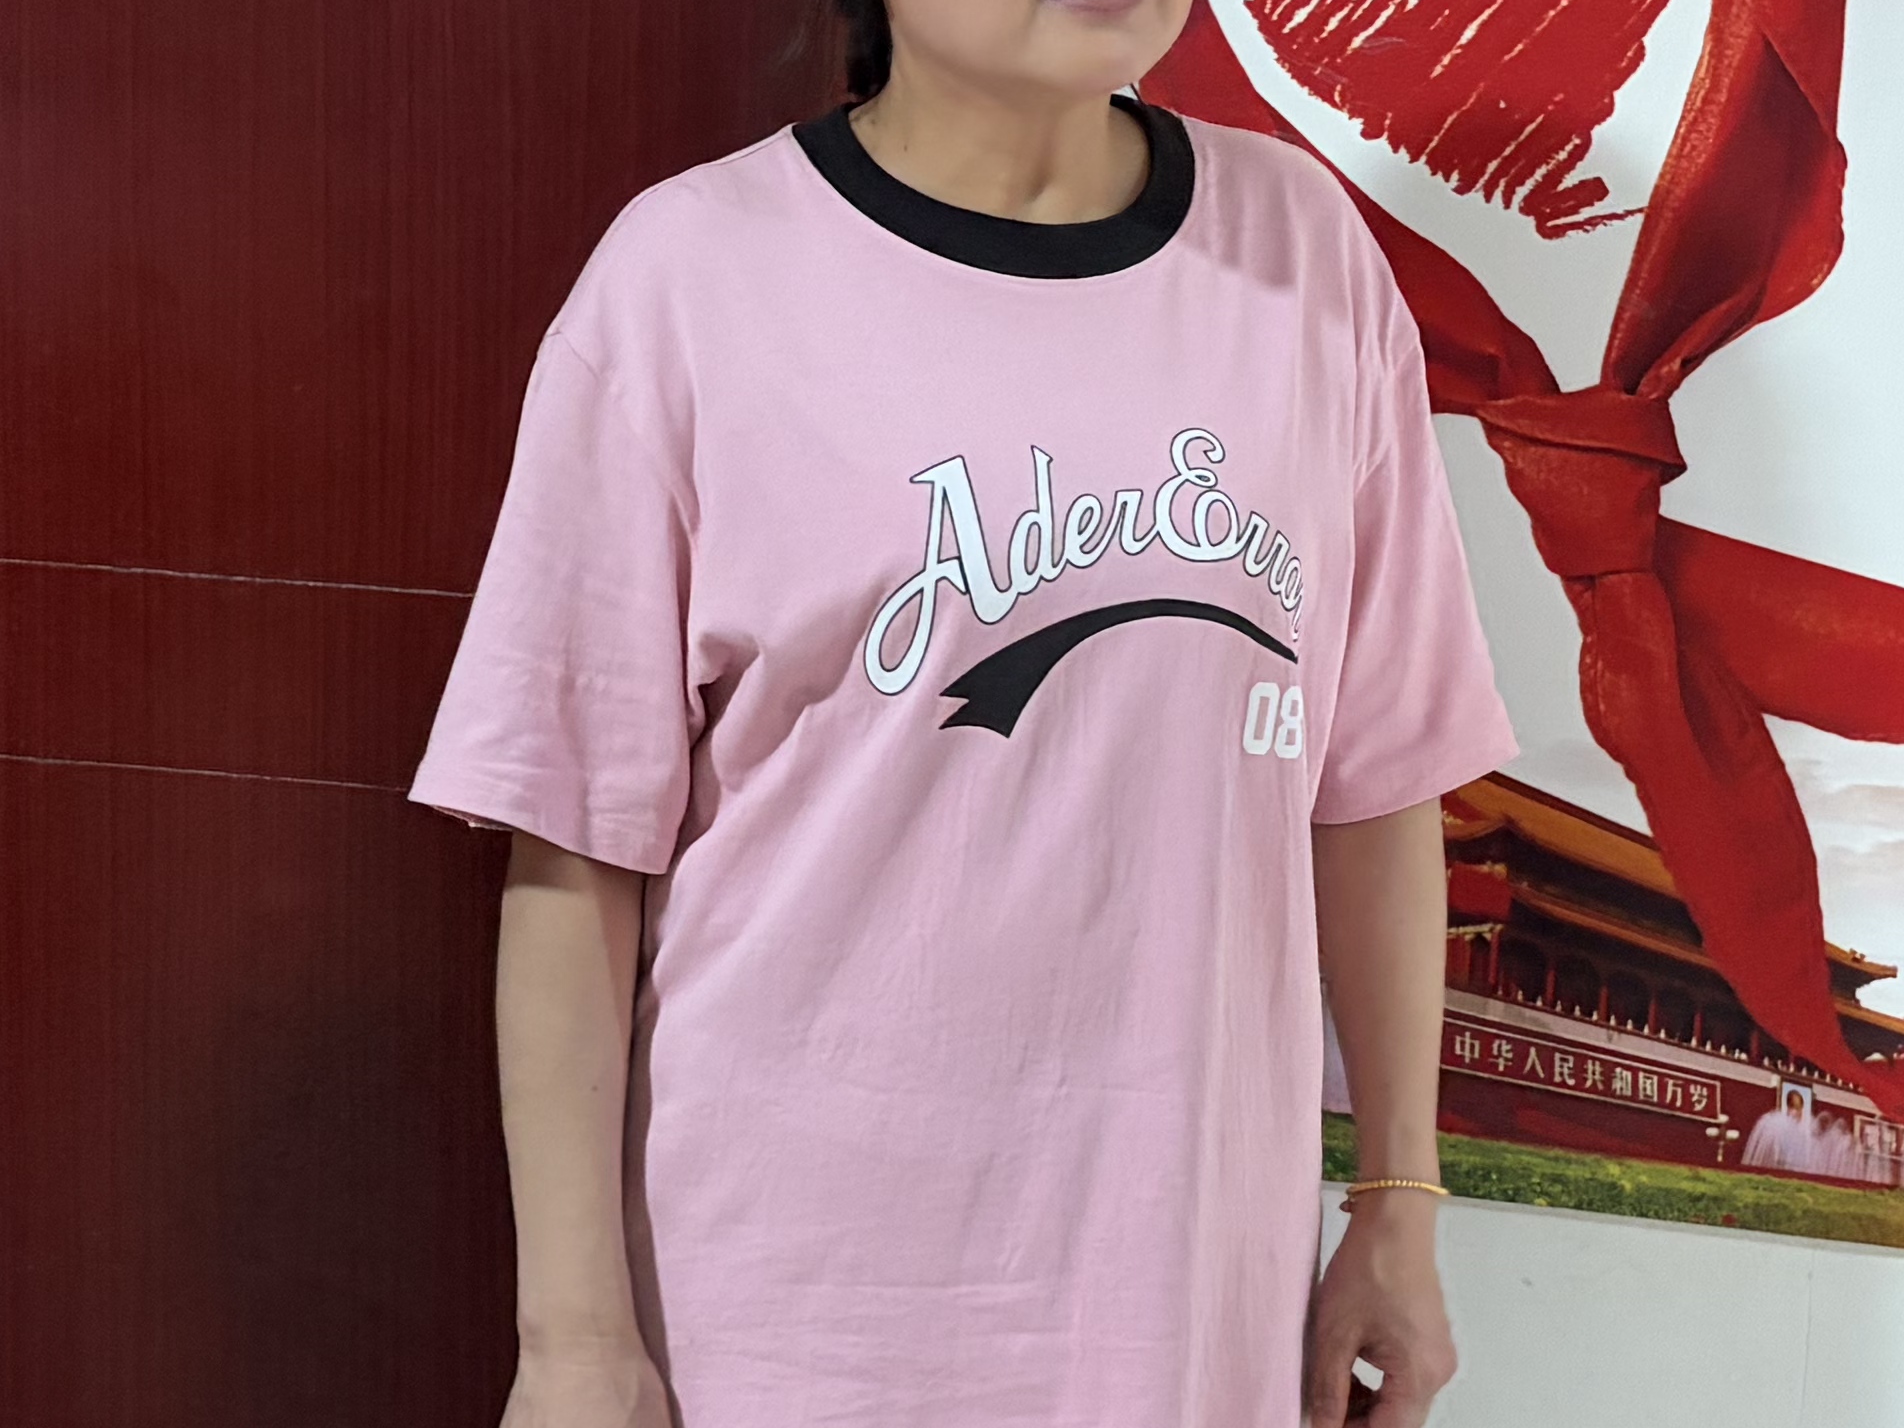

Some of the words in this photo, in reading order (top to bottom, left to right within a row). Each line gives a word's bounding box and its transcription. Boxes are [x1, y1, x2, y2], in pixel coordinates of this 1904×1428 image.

[1242, 681, 1305, 760] 08
[1453, 1029, 1709, 1112] 中华人民共和国万岁
